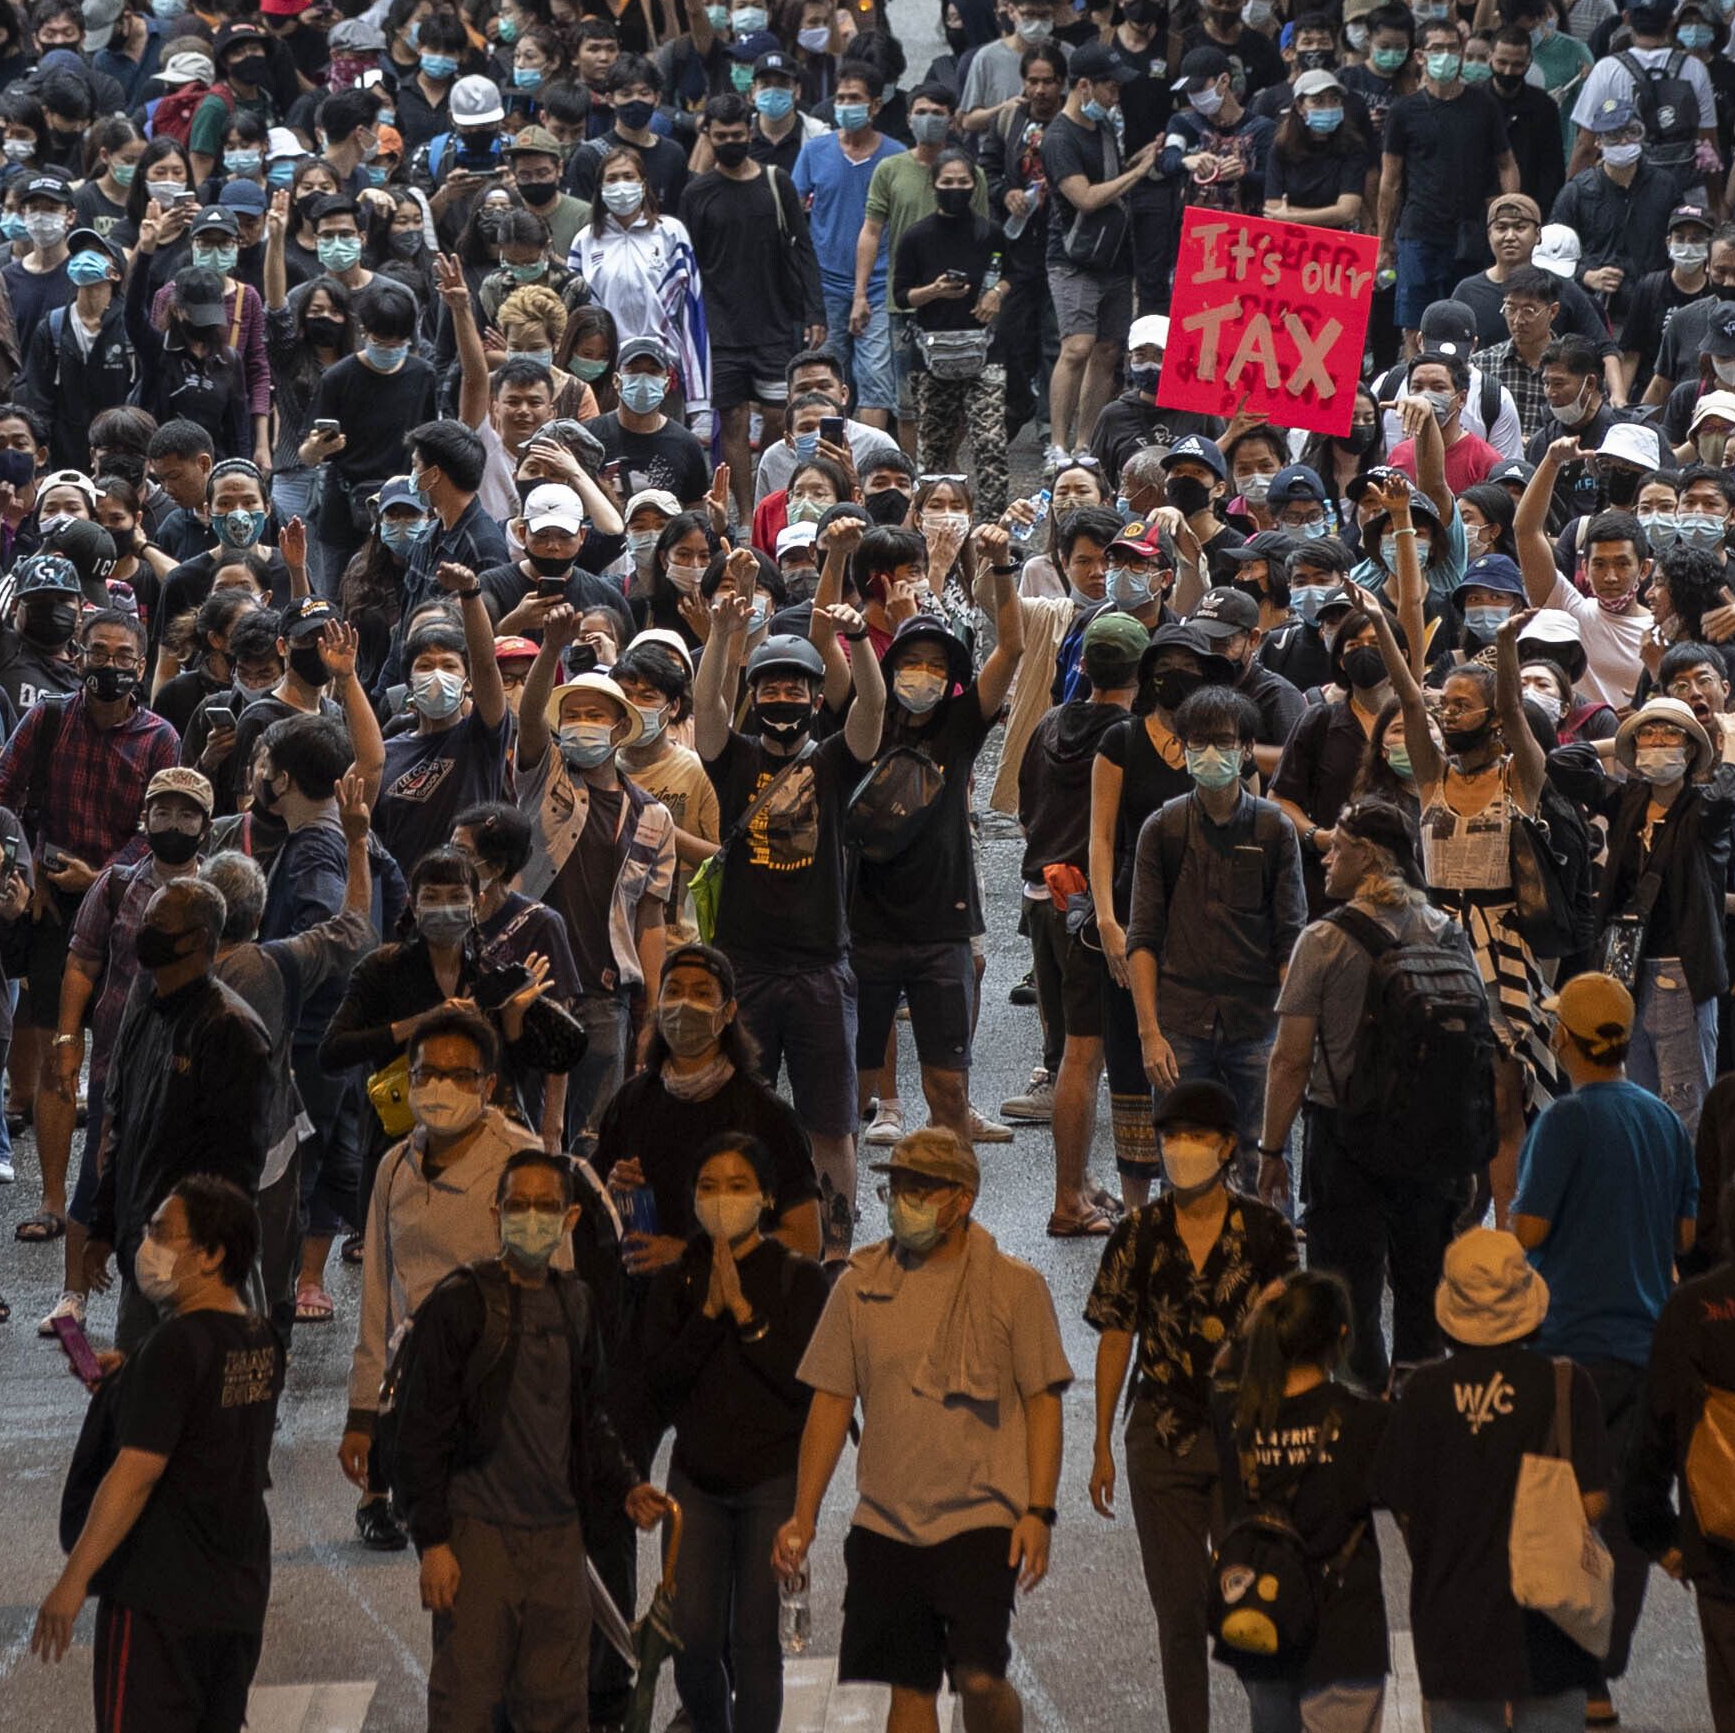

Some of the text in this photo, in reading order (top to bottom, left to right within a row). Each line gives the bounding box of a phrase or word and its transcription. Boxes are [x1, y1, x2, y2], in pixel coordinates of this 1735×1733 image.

[1190, 223, 1283, 286] It's
[1301, 260, 1373, 299] our
[1182, 296, 1344, 400] TAX
[1281, 1426, 1340, 1447] FRIED
